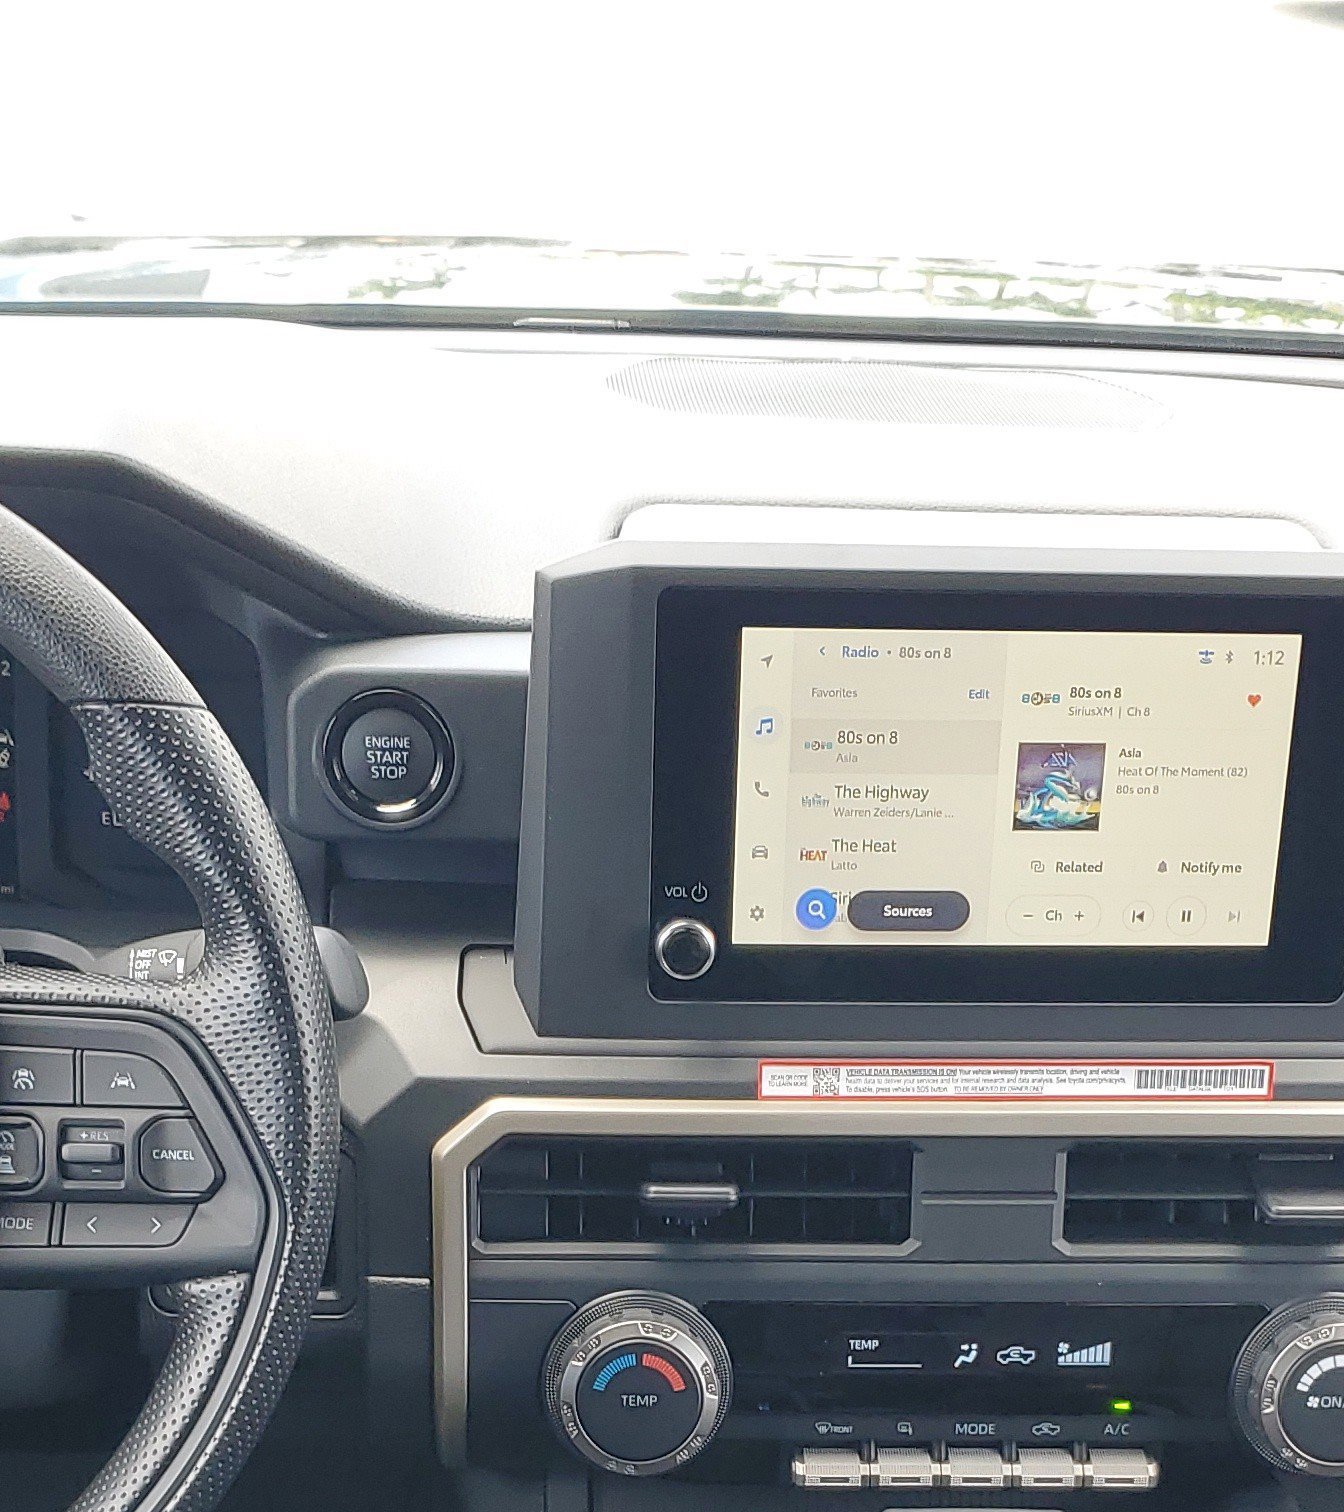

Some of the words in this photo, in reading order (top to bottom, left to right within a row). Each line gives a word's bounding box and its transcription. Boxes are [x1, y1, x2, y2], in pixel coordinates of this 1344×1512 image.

[842, 646, 879, 658] Radio
[899, 648, 921, 659] 80s
[925, 650, 940, 659] on
[943, 648, 952, 659] 8
[1253, 650, 1285, 666] 1:12
[811, 687, 858, 699] Favorites
[968, 688, 990, 700] Edit
[1069, 687, 1092, 699] 80s
[1094, 690, 1112, 699] on
[1113, 687, 1122, 699] 8
[1068, 706, 1113, 717] SiriusXM
[1127, 706, 1141, 717] Ch
[1143, 707, 1151, 717] 8
[365, 736, 411, 749] ENGINE
[837, 730, 863, 745] 80s
[866, 733, 886, 745] on
[889, 730, 898, 745] 8
[366, 751, 409, 765] START
[836, 752, 858, 764] Asia
[1118, 748, 1142, 759] Asia
[371, 766, 407, 779] STOP
[1117, 766, 1143, 777] Heat
[1161, 766, 1179, 777] The
[1181, 766, 1224, 778] Moment
[1227, 766, 1248, 778] (82)
[835, 785, 862, 800] The
[865, 785, 929, 804] Highway
[1116, 785, 1134, 796] 80s
[1137, 787, 1151, 796] on
[1152, 785, 1159, 796] 8
[833, 807, 871, 819] Warren
[873, 807, 942, 820] Zeiders/Lanie
[832, 839, 859, 853] The
[862, 839, 897, 853] Heat
[831, 860, 858, 871] Latto
[1055, 861, 1103, 873] Related
[1181, 862, 1220, 877] Notify
[1221, 865, 1242, 873] me
[664, 886, 688, 898] VOL
[883, 904, 933, 918] Sources
[1045, 910, 1063, 922] Ch
[134, 960, 152, 970] OFF
[152, 1149, 195, 1161] CANCEL
[849, 1339, 880, 1350] TEMP
[620, 1394, 658, 1407] TEMP
[830, 1425, 853, 1434] FRONT
[956, 1423, 996, 1435] MODE
[1104, 1423, 1130, 1436] A/C
